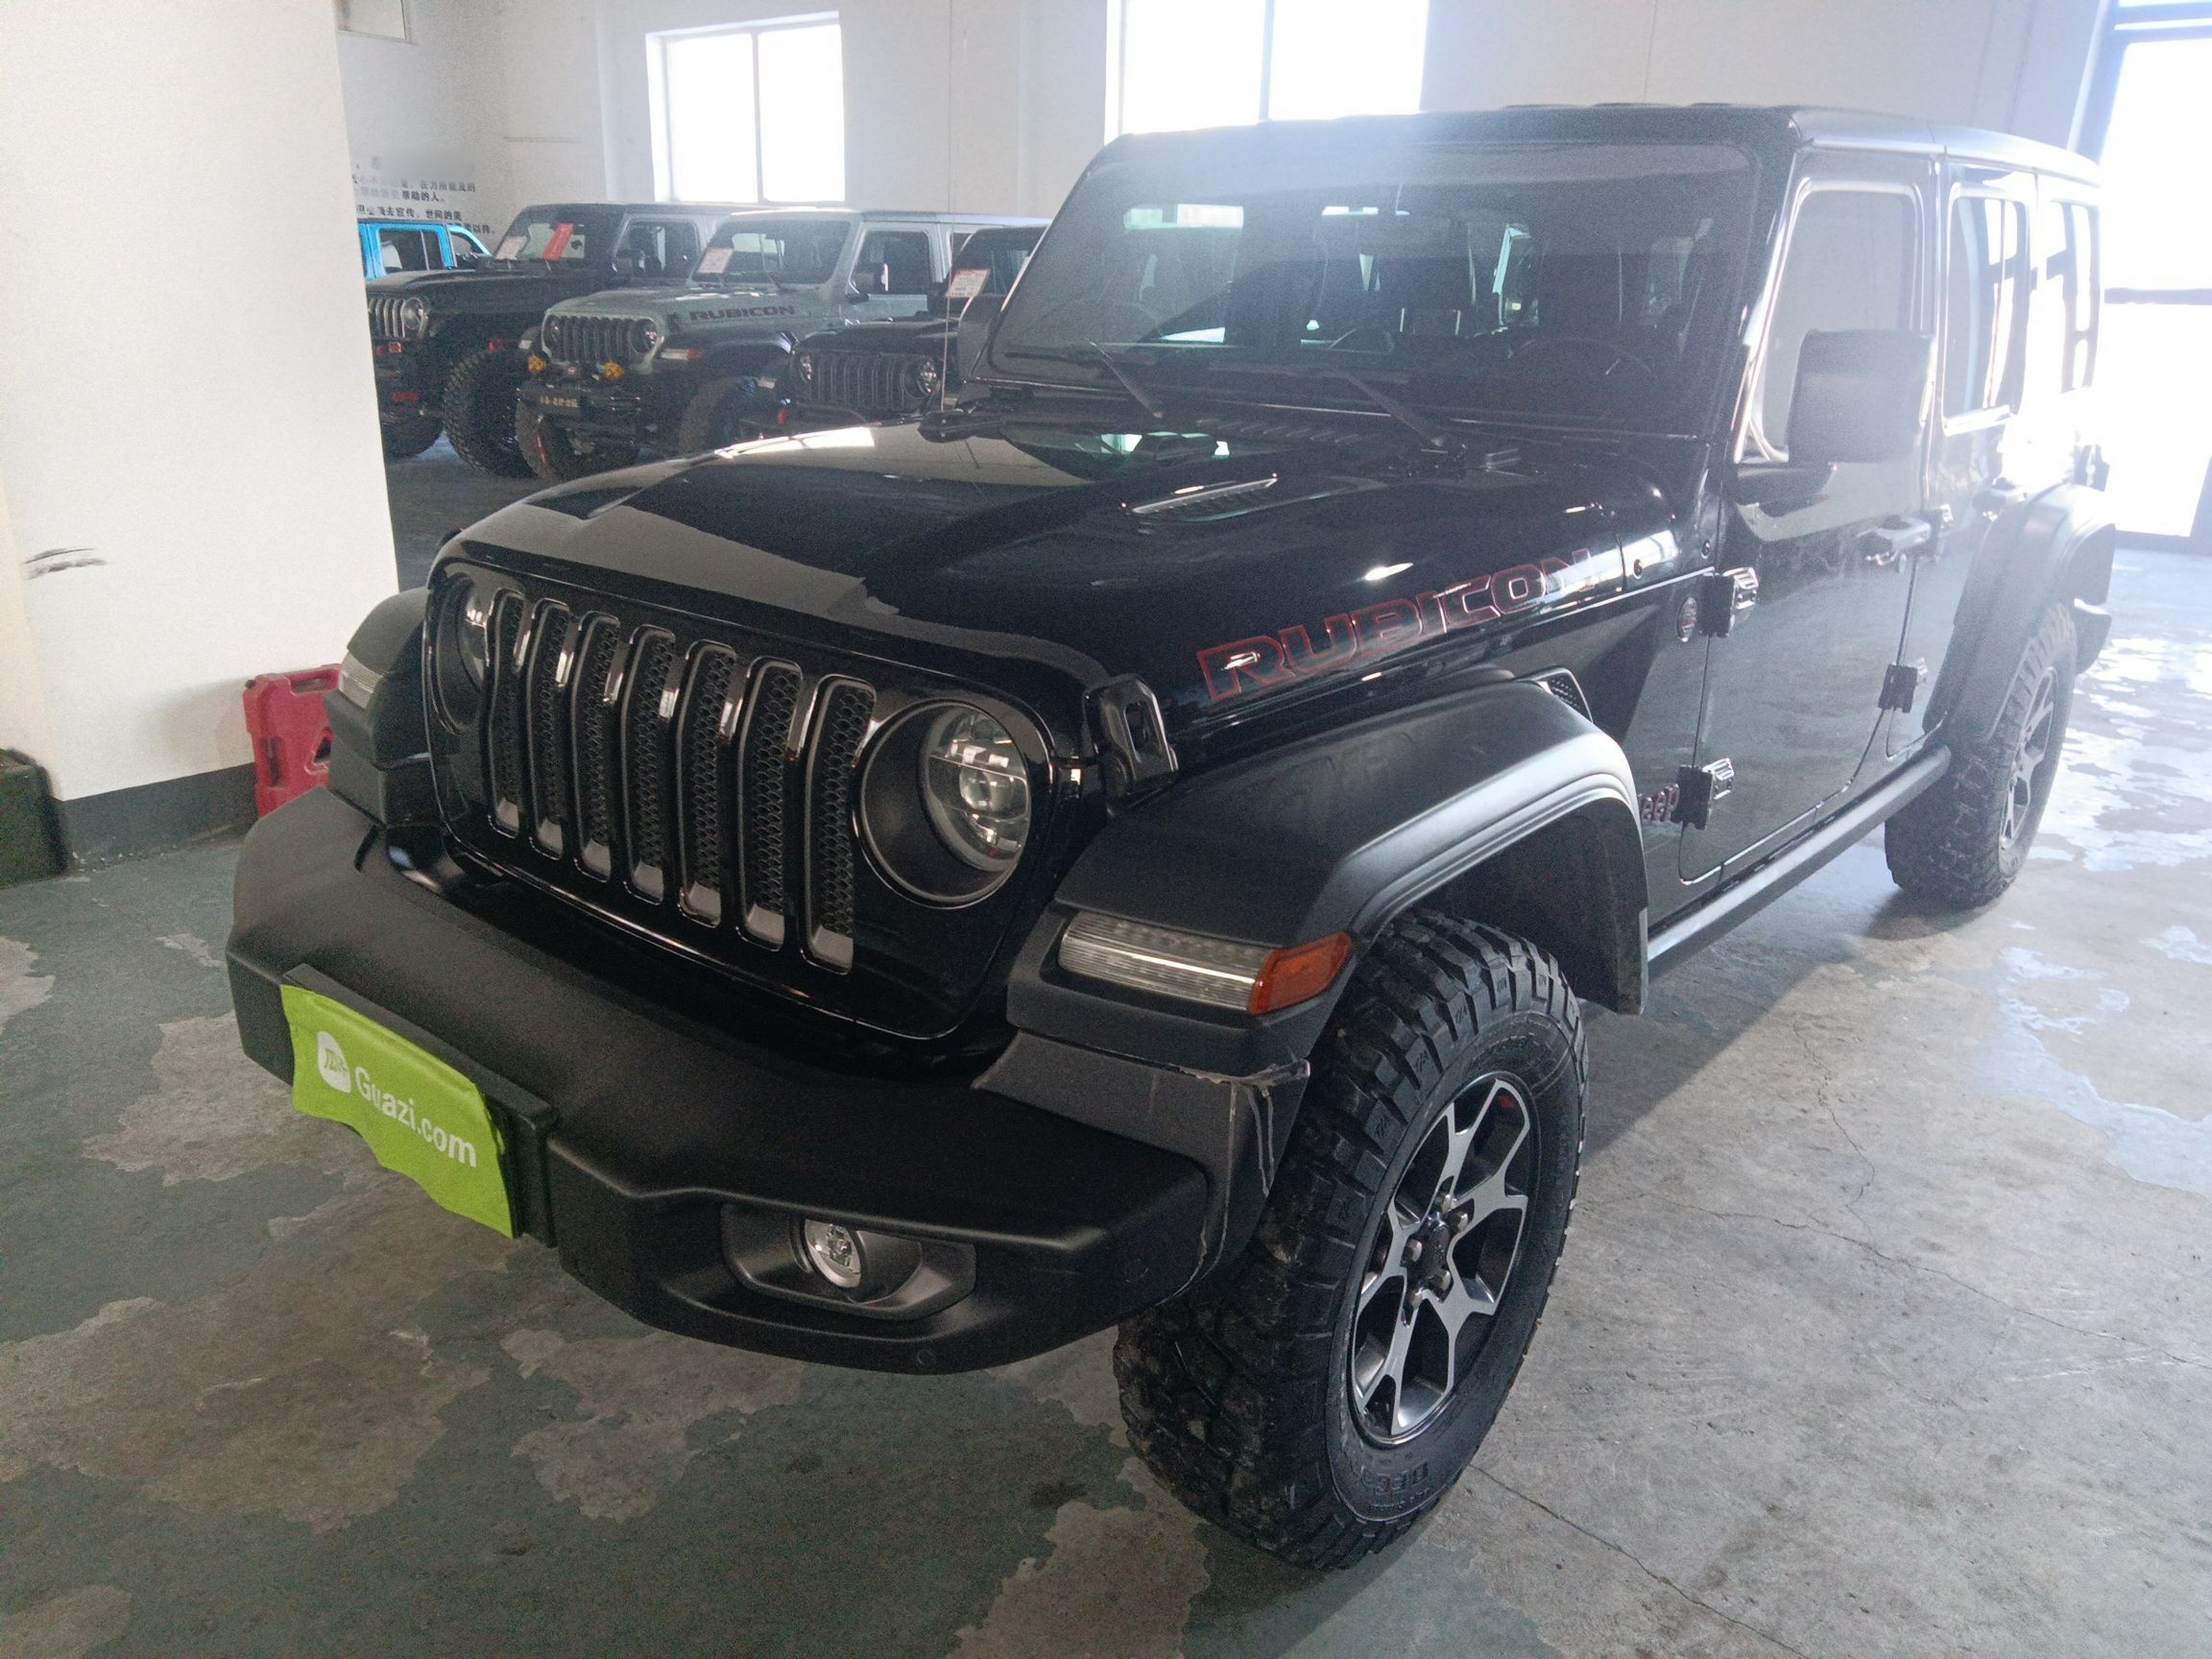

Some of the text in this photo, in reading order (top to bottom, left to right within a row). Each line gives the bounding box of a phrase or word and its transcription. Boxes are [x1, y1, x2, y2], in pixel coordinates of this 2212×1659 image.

[690, 306, 795, 320] RUBICON
[1197, 549, 1596, 702] RUBICON
[1639, 782, 1680, 825] eep
[355, 1066, 476, 1168] Guazi.com
